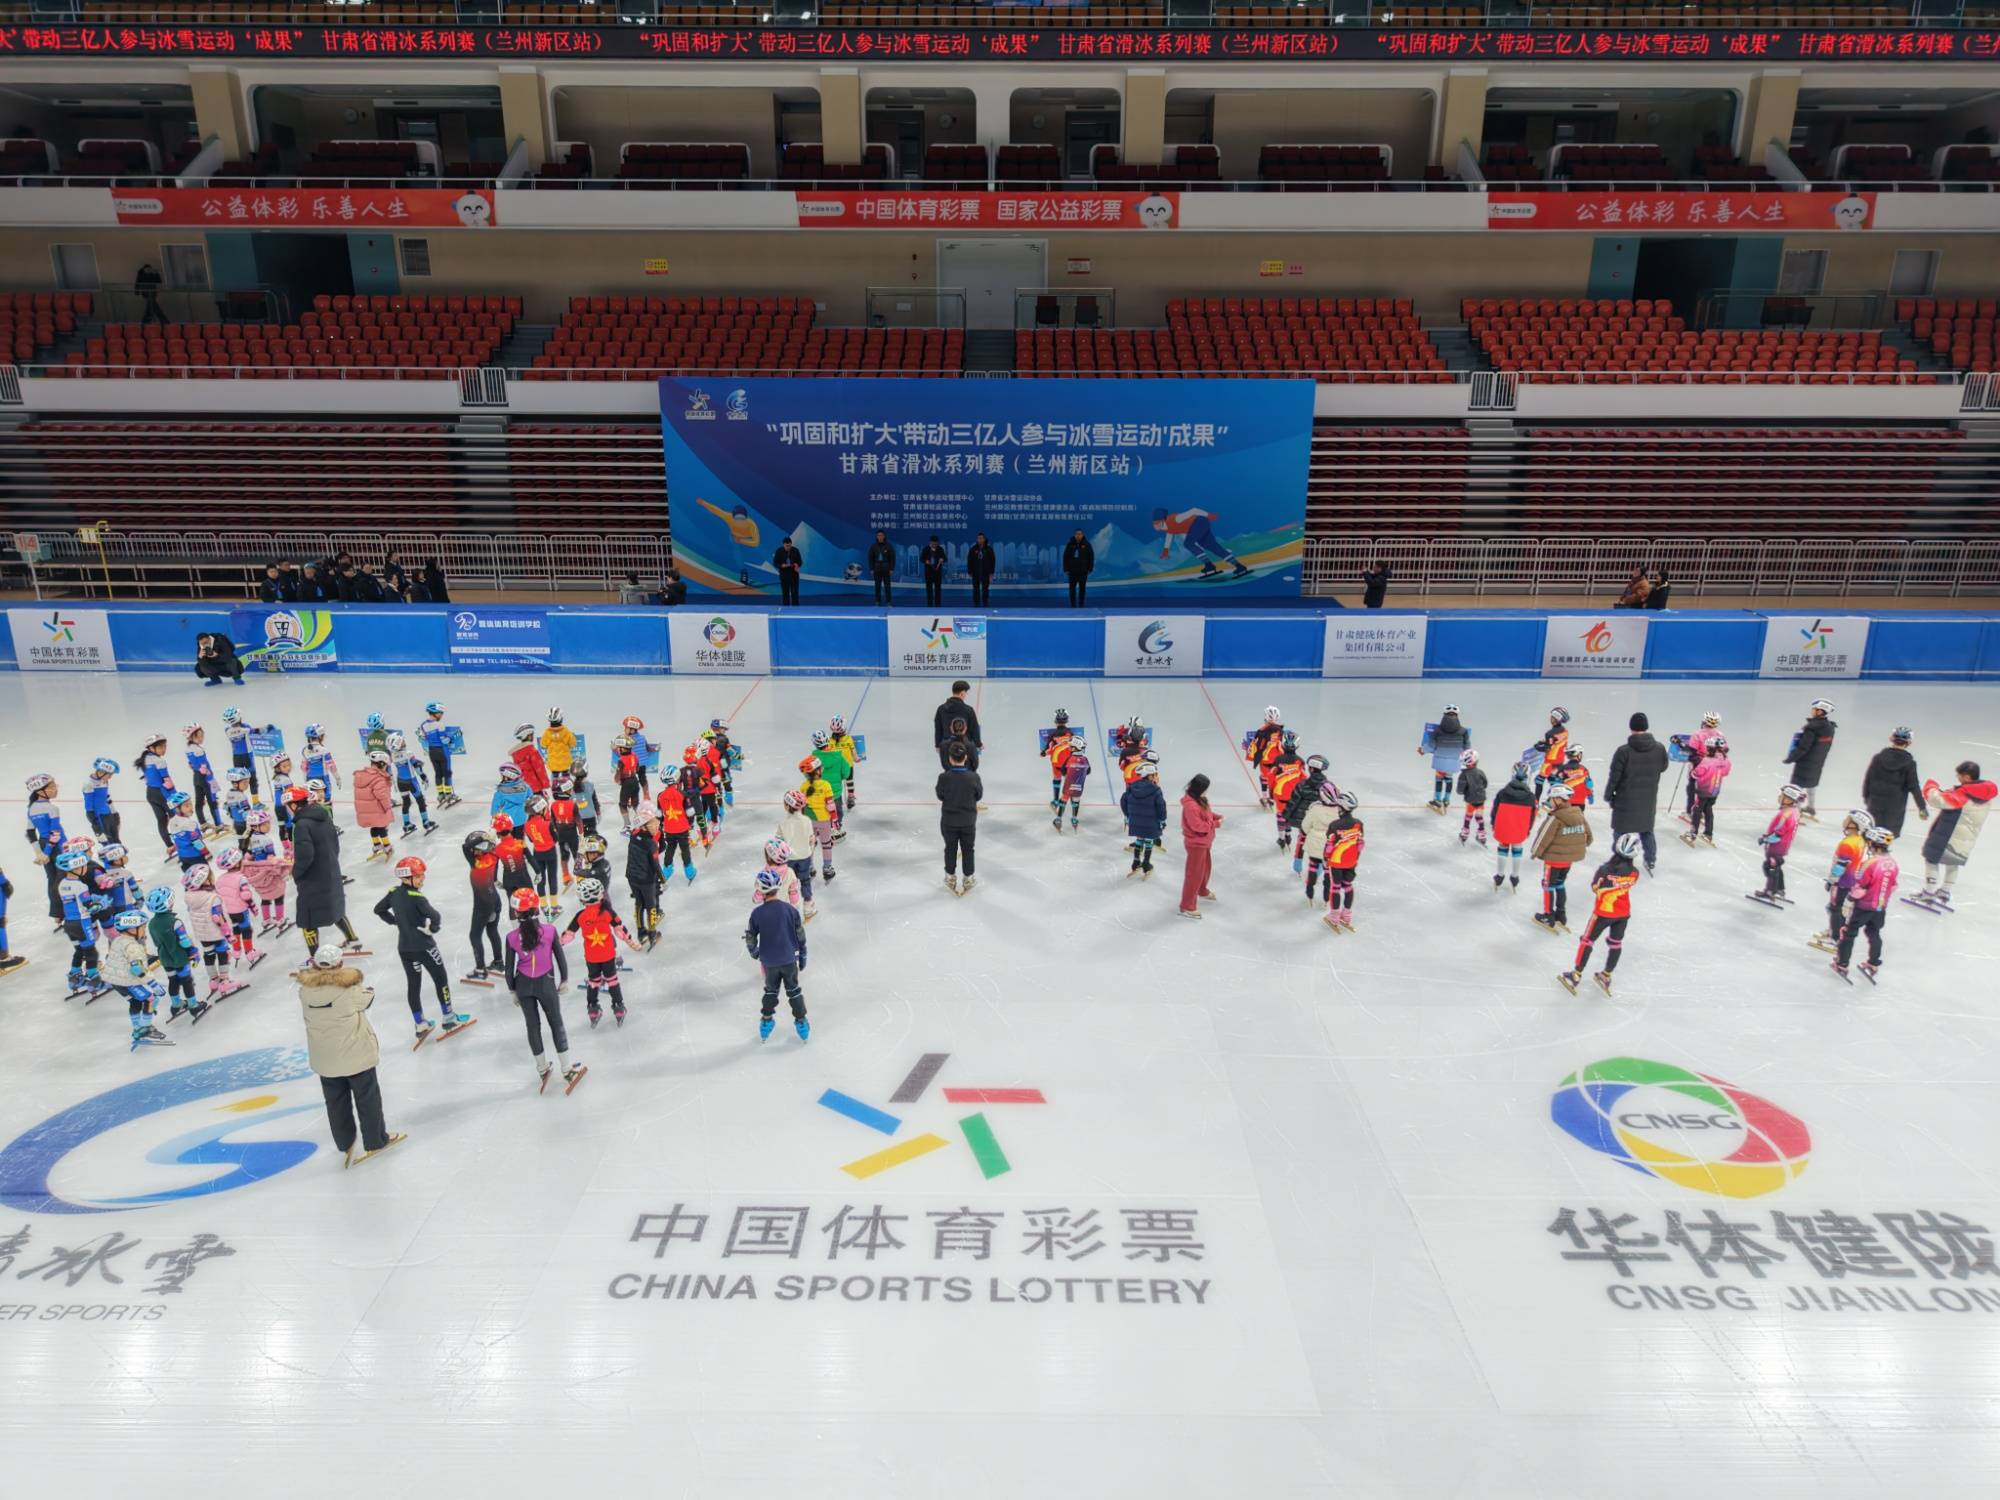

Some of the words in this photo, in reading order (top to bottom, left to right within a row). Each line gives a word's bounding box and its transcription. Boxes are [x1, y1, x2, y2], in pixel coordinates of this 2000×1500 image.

[201, 195, 298, 219] 公益体彩
[312, 195, 409, 219] 乐善人生
[856, 198, 980, 221] 中国体育彩票
[997, 199, 1122, 221] 国家公益彩票
[1575, 199, 1674, 222] 公益体彩
[1687, 199, 1785, 222] 乐善人生
[29, 647, 100, 658] 中国体育彩票
[695, 650, 746, 662] 华体健陇
[903, 653, 972, 665] 中国体育彩票
[1345, 642, 1405, 653] 集团有限公司
[1776, 654, 1848, 666] 中国体育彩票
[1618, 1112, 1743, 1131] CNSG
[628, 1203, 1205, 1264] 中国体育彩票
[1546, 1206, 2000, 1281] 华体健陇
[0, 1223, 237, 1296] 冰雪
[606, 1273, 758, 1300] CHINA
[774, 1275, 972, 1303] SPORTS
[989, 1277, 1212, 1305] LOTTERY
[1606, 1284, 1758, 1311] CNSG
[38, 1304, 168, 1321] SPORTS
